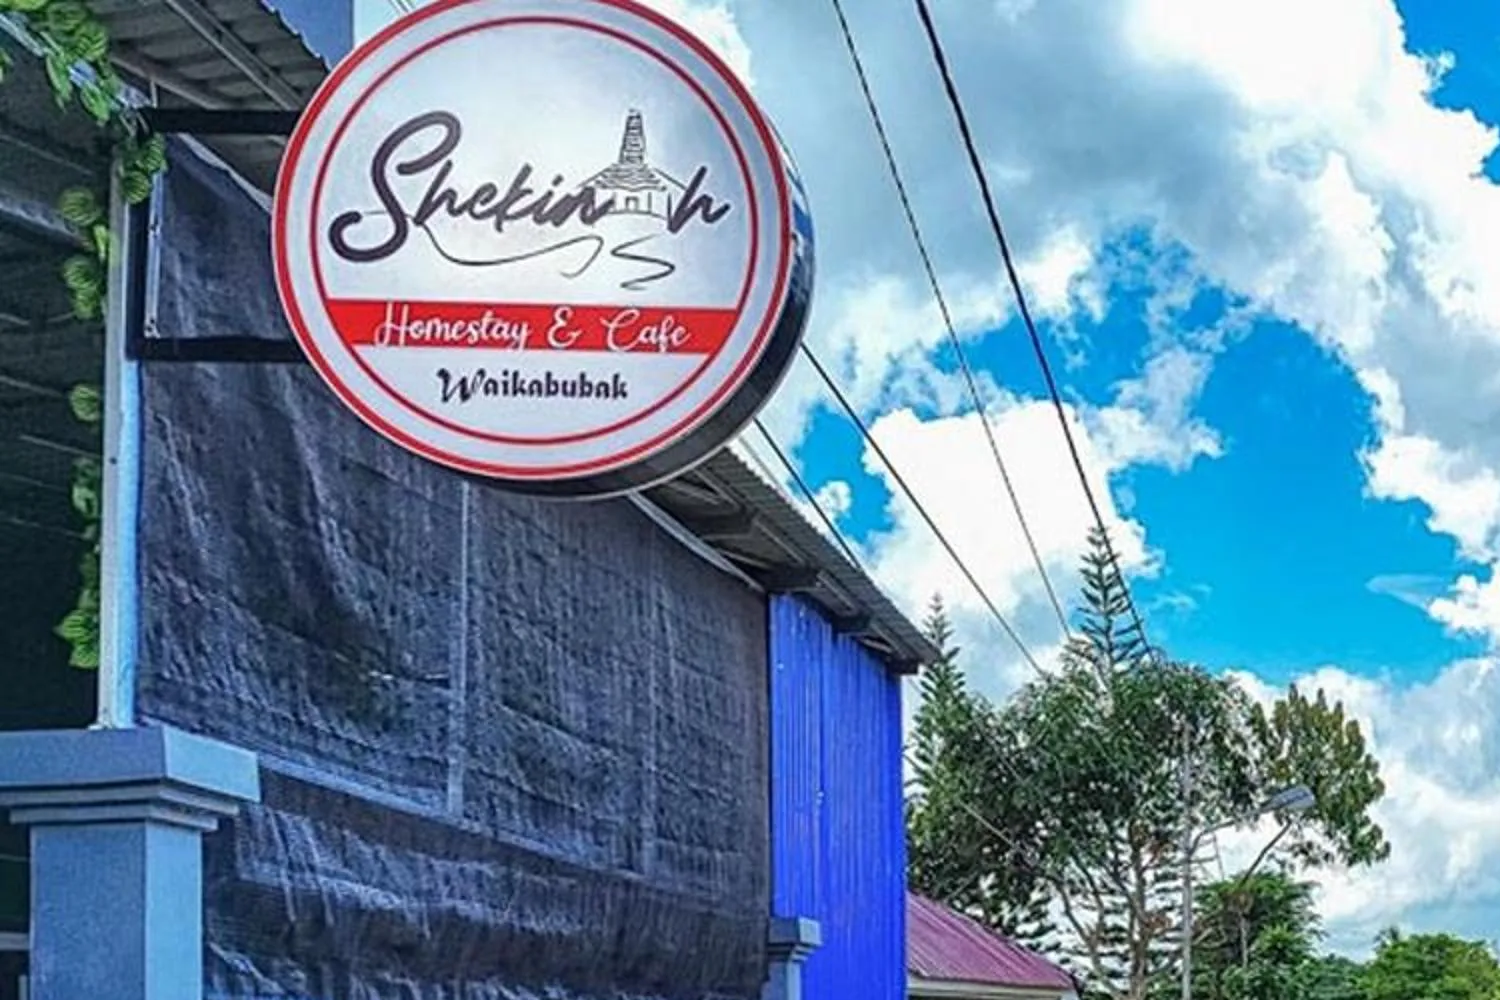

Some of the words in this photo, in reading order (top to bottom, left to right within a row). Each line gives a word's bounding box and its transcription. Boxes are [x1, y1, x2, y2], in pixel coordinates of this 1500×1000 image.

[328, 110, 730, 263] Shekinh
[374, 303, 531, 350] Homestay
[547, 306, 582, 349] &
[600, 309, 690, 353] Cafe
[437, 368, 628, 402] Waikabubak
